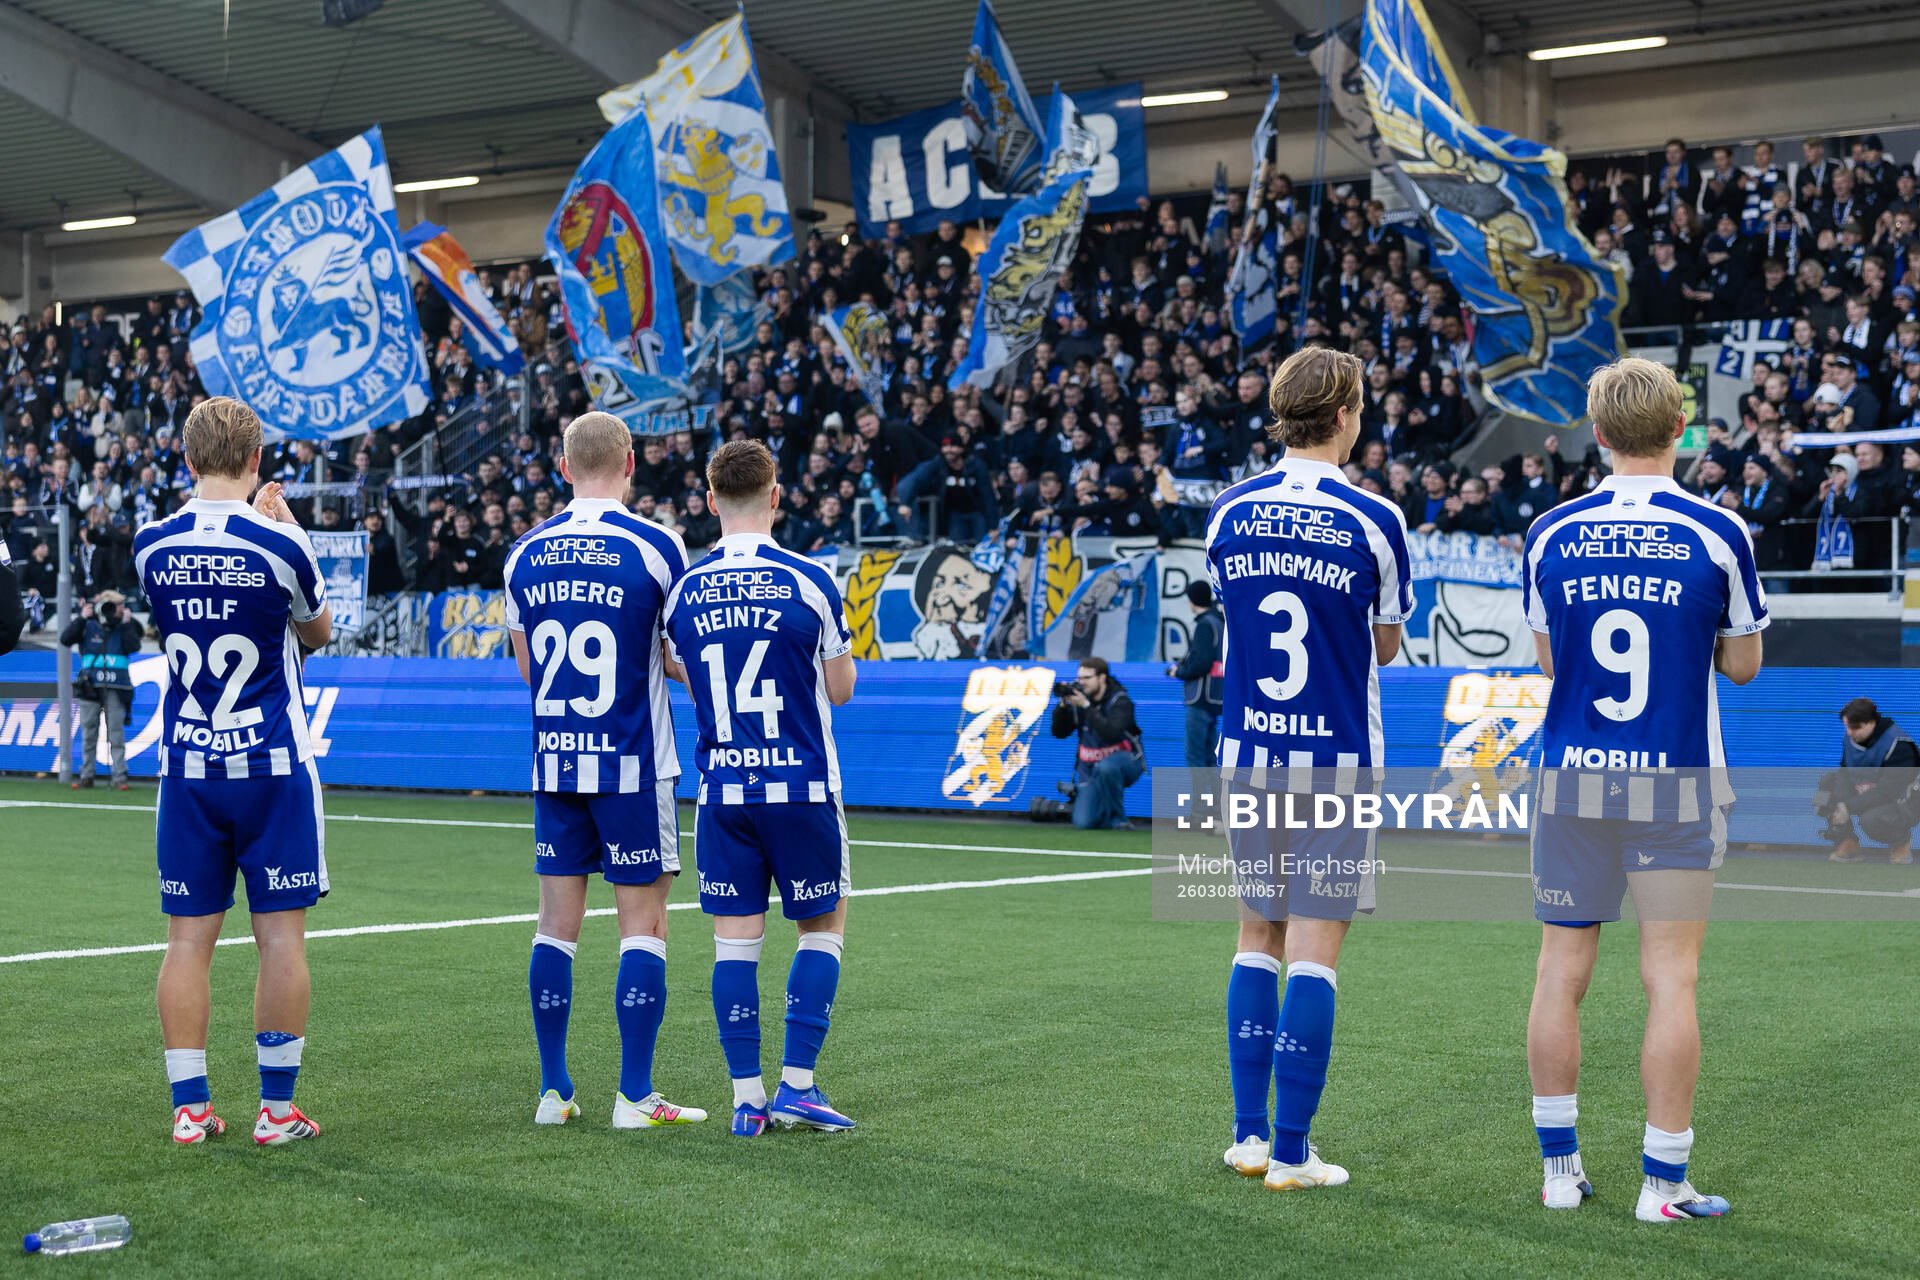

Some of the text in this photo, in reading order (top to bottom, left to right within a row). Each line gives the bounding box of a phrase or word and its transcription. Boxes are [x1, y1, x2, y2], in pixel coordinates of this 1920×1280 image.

[868, 112, 1119, 222] ACB
[1252, 504, 1334, 526] NORDIC
[1233, 520, 1353, 547] WELLNESS
[1579, 524, 1669, 541] NORDIC
[544, 538, 606, 553] NORDIC
[1559, 541, 1690, 561] WELLNESS
[168, 555, 246, 571] NORDIC
[530, 551, 621, 567] WELLNESS
[152, 571, 265, 587] WELLNESS
[700, 571, 773, 590] NORDIC
[1224, 552, 1357, 594] ERLINGMARK
[523, 580, 625, 608] WIBERG
[684, 585, 792, 605] WELLNESS
[1562, 575, 1683, 606] FENGER
[172, 598, 238, 621] TOLF
[693, 606, 782, 637] HEINTZ
[1746, 621, 1762, 633] IFK
[1256, 591, 1309, 701] 3
[531, 619, 617, 717] 29
[1591, 609, 1649, 722] 9
[165, 633, 264, 731] 22
[700, 640, 784, 743] 14
[1244, 706, 1333, 737] MOBILL
[173, 721, 264, 752] MOBILL
[538, 731, 616, 752] MOBILL
[708, 747, 803, 770] MOBILL
[1561, 745, 1675, 774] MOBILL
[536, 842, 556, 857] STA
[611, 847, 660, 865] RASTA
[160, 881, 190, 896] ASTA
[268, 871, 318, 890] RASTA
[793, 880, 837, 901] RASTA
[1308, 879, 1359, 898] RASTA
